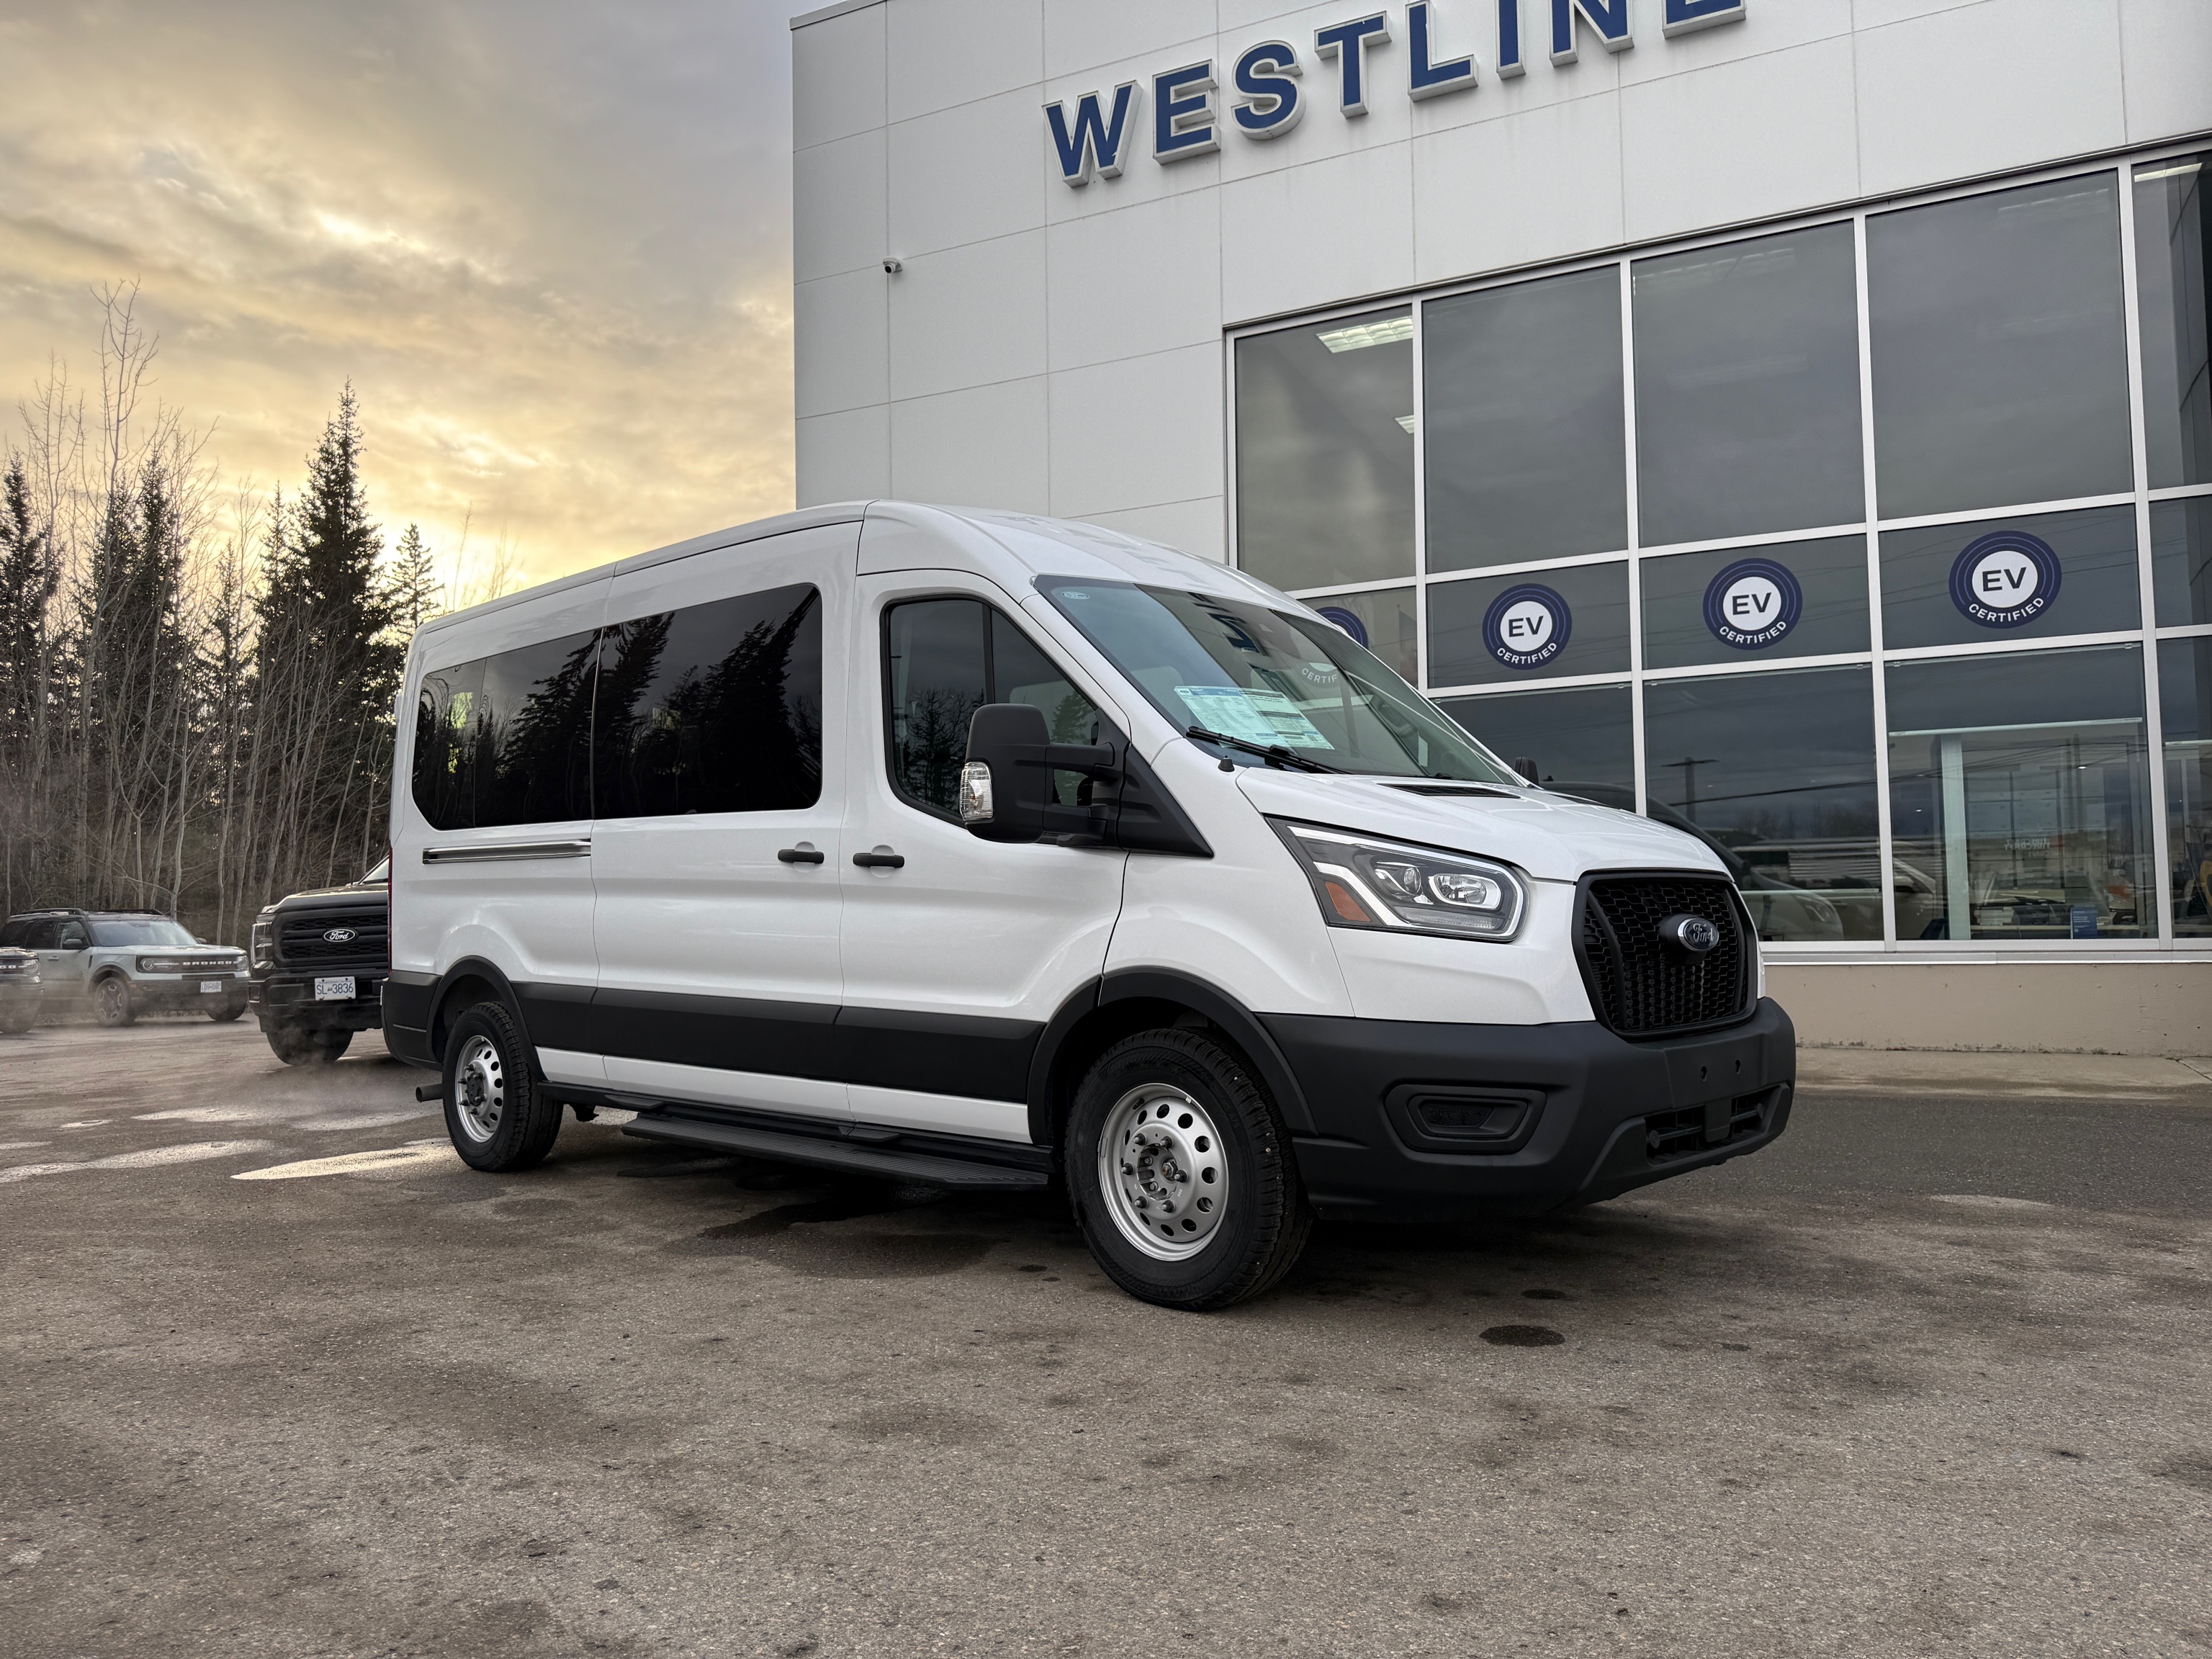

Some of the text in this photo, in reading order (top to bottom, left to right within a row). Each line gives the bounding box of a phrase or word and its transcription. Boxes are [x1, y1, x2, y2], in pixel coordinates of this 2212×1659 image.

[1982, 567, 2027, 592] EV
[1732, 593, 1771, 615] EV
[1969, 597, 2044, 622] CERTIFIED
[1509, 616, 1544, 637] EV
[1719, 621, 1786, 644] CERTIFIED
[1497, 642, 1557, 665] CERTIFIED
[1301, 667, 1338, 684] CERTIF
[330, 930, 349, 940] Ford
[1693, 923, 1714, 943] Ford
